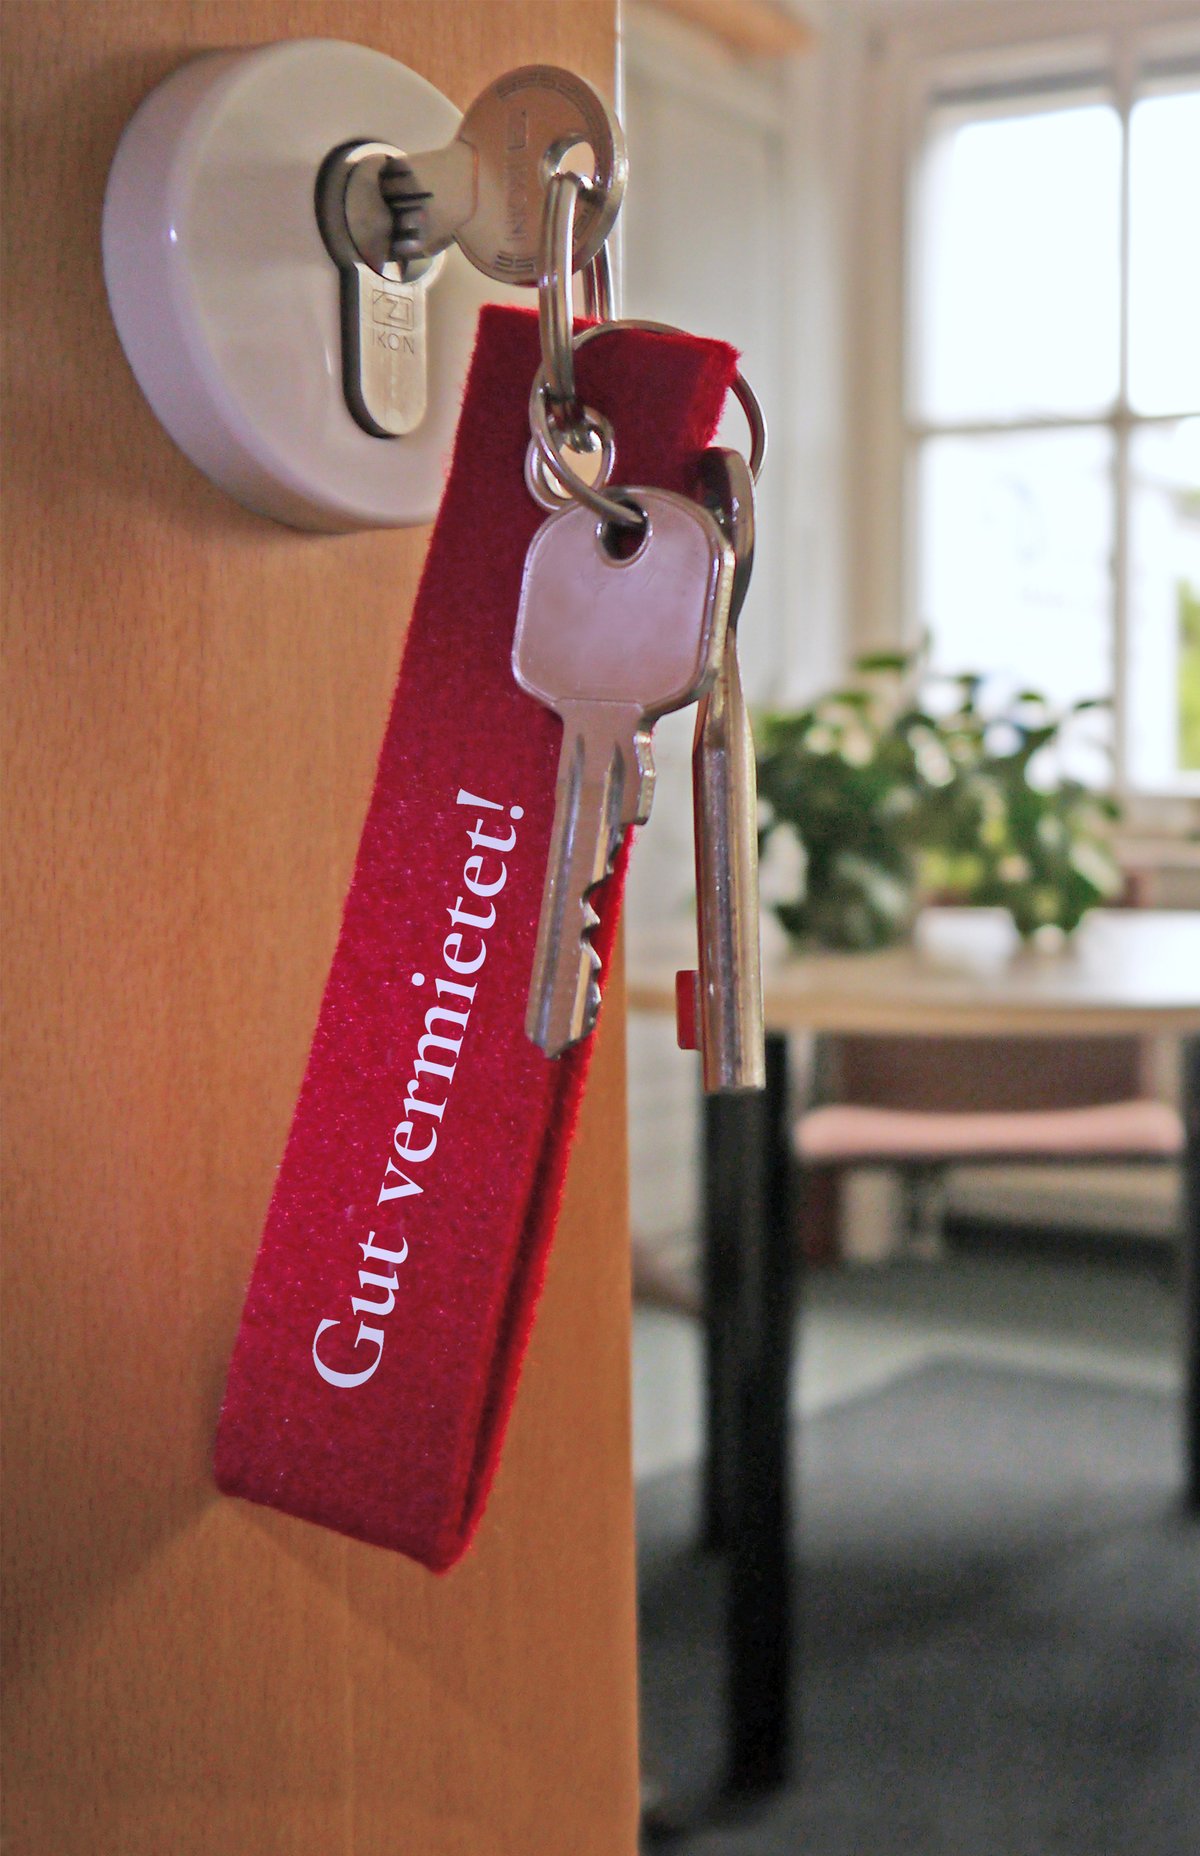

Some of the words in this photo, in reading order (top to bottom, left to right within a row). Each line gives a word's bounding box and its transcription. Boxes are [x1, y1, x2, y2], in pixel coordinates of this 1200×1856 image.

[371, 329, 415, 355] IKON
[312, 1230, 409, 1388] Gut
[376, 788, 524, 1206] vermietet!
